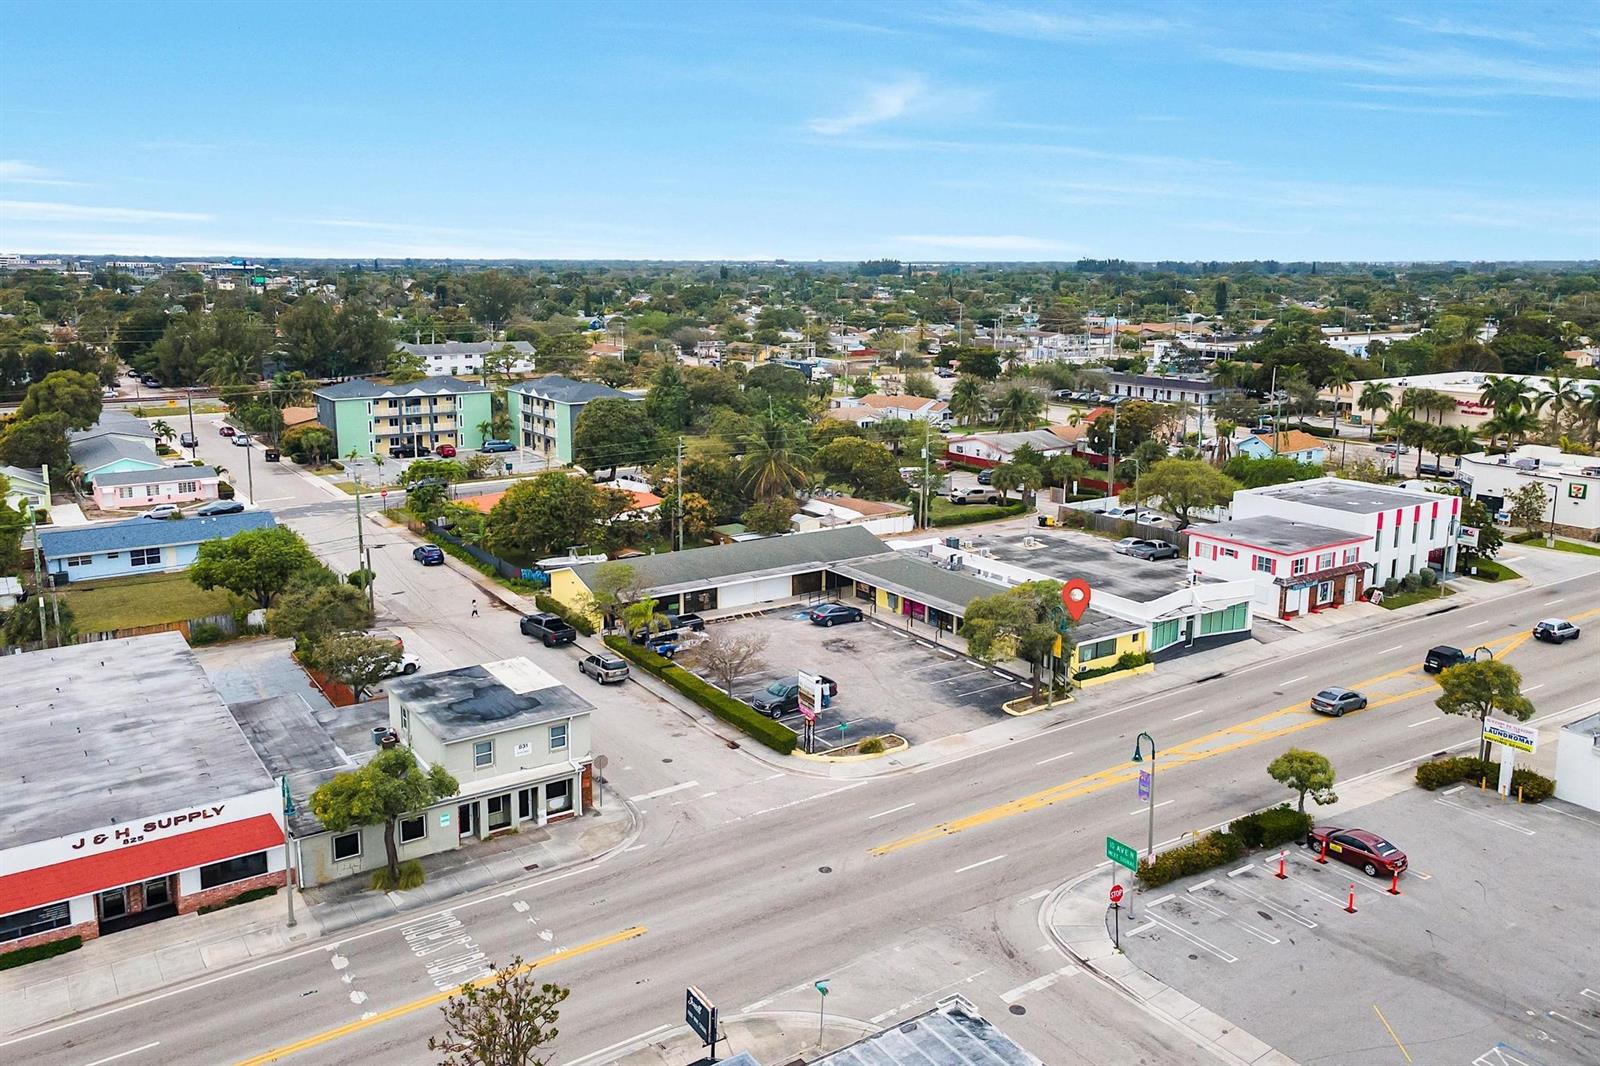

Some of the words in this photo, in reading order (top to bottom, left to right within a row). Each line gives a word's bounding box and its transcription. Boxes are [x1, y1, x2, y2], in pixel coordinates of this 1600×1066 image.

[1484, 727, 1534, 746] LAUNDROMAT
[72, 838, 85, 849] J
[93, 834, 109, 845] &
[115, 827, 130, 840] H
[143, 804, 225, 833] SUPPLY
[122, 835, 144, 845] 825
[1117, 845, 1129, 857] AVE
[1110, 890, 1123, 899] STOP
